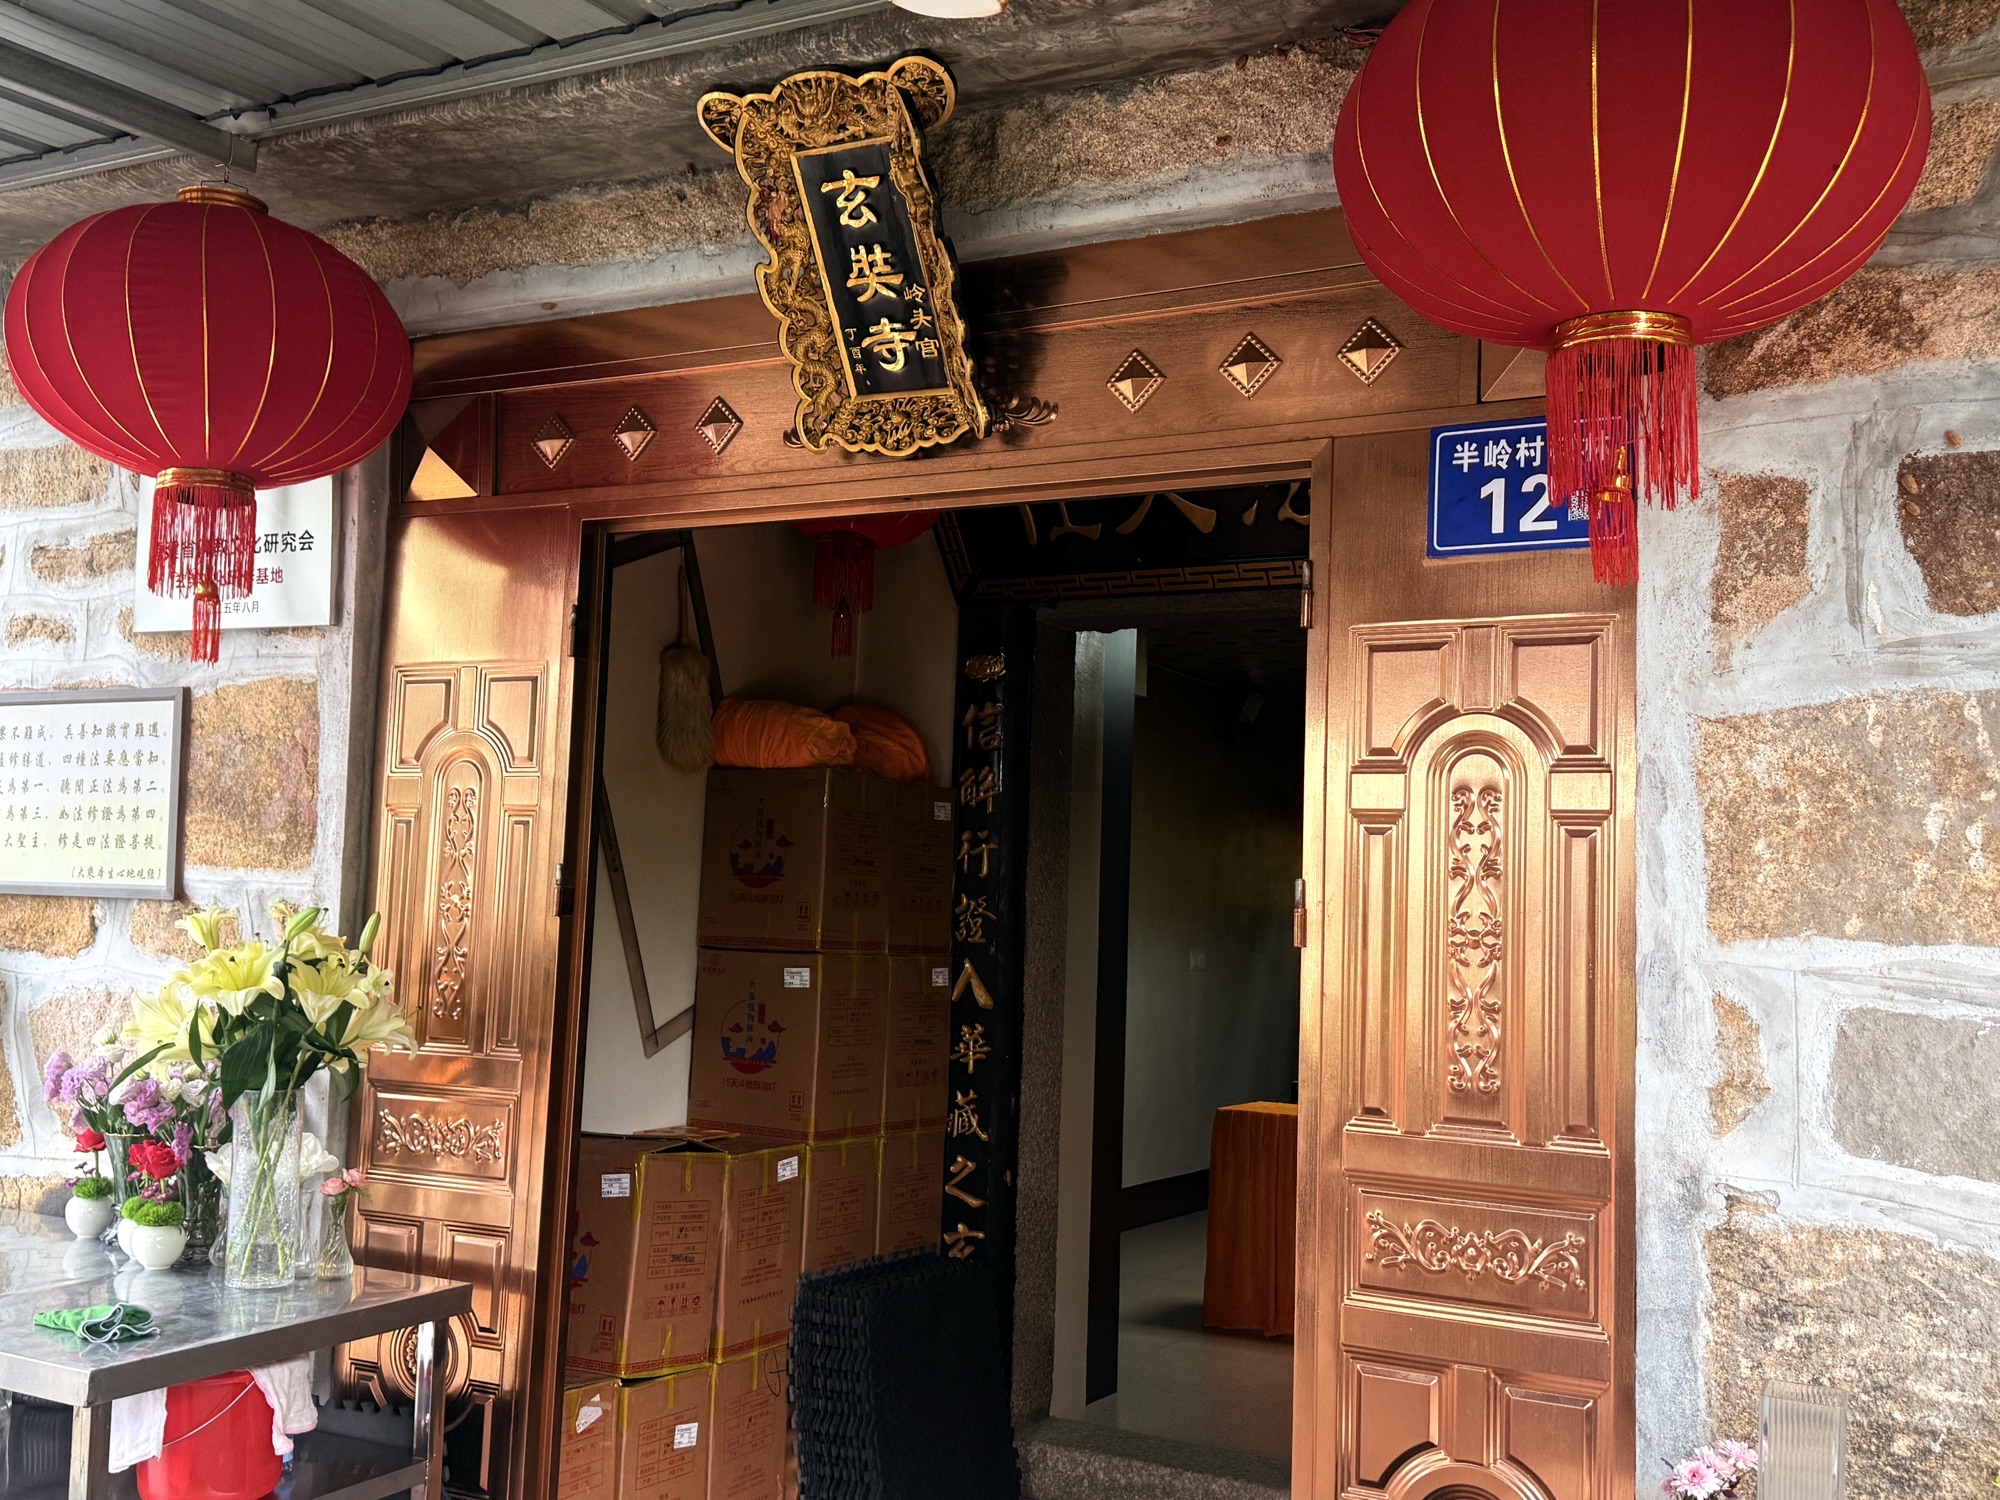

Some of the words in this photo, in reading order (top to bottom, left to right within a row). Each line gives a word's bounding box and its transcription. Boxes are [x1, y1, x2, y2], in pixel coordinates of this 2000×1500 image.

[820, 169, 918, 372] 玄奘寺
[1452, 435, 1545, 473] 半岭村
[1480, 473, 1558, 534] 12
